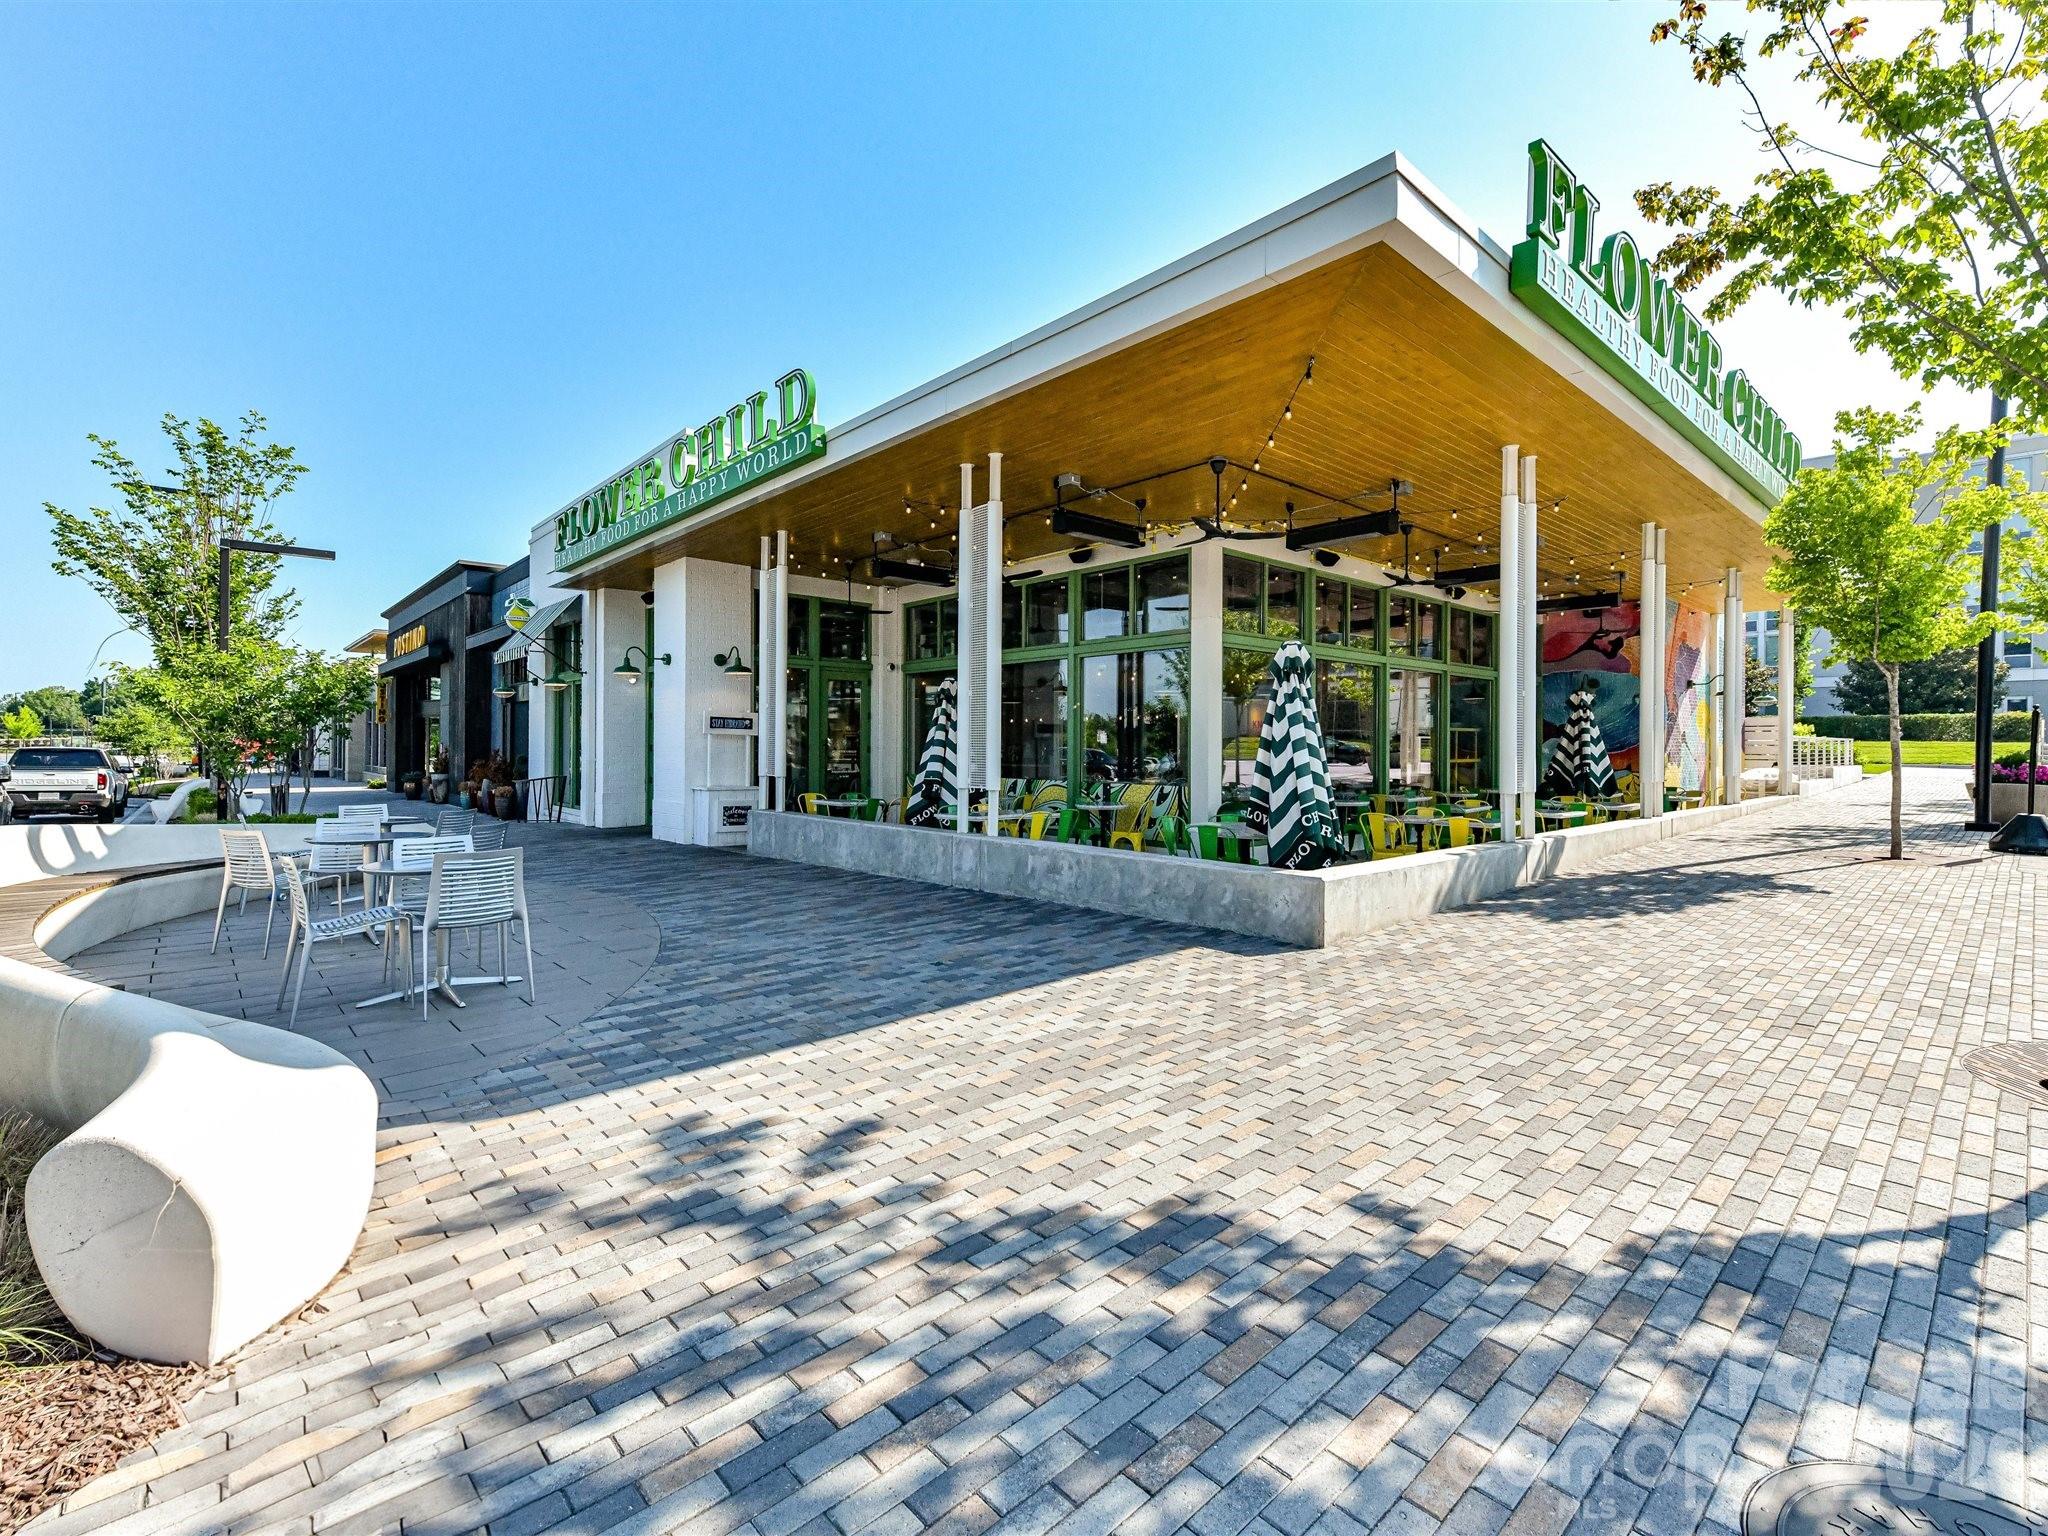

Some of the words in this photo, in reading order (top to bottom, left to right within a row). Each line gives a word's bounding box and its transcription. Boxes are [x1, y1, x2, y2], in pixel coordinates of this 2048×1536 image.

[1527, 138, 1723, 410] FLOWER
[1724, 368, 1802, 486] CHILD
[1541, 249, 1642, 370] HEALTHY
[1649, 353, 1690, 419] FOOD
[1694, 396, 1720, 441] FOR
[1722, 427, 1730, 453] A
[1733, 436, 1767, 484] HAPPY
[554, 457, 665, 552] FLOWER
[669, 368, 816, 490] CHILD
[555, 535, 599, 569] HEALTHY
[601, 520, 630, 546] FOOD
[634, 506, 659, 531] FOR
[663, 500, 672, 518] A
[677, 469, 729, 511] HAPPY
[735, 431, 808, 481] WORLD
[393, 624, 427, 658] POSTINO
